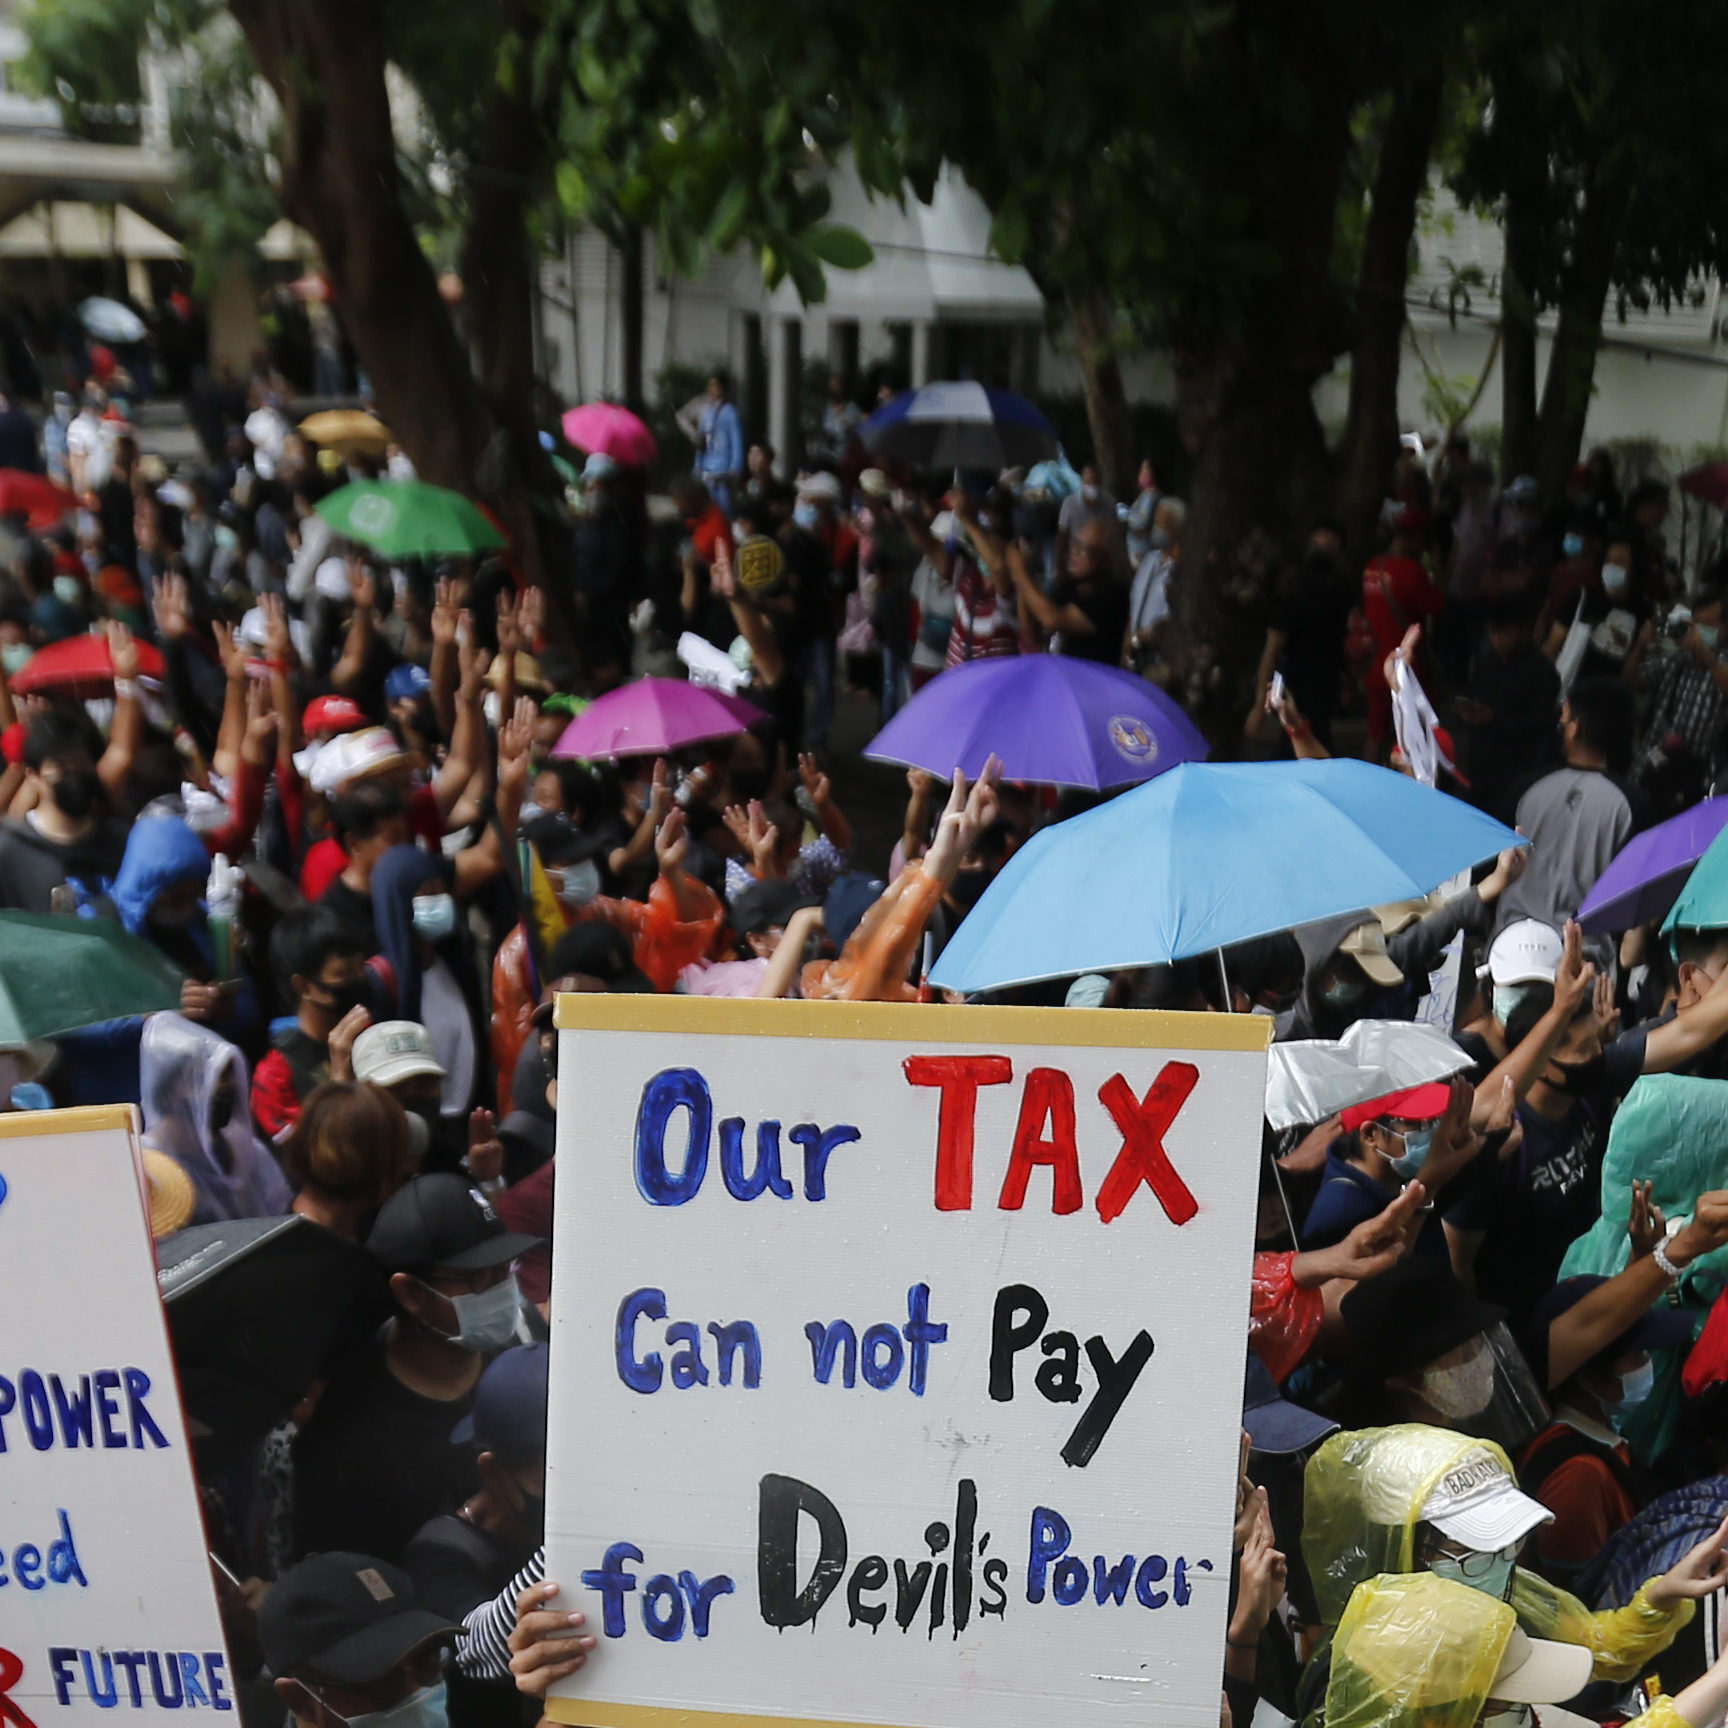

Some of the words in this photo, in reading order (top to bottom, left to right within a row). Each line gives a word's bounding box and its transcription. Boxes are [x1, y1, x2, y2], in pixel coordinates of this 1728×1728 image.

[634, 1067, 860, 1206] Our
[903, 1055, 1200, 1225] TAX
[616, 1286, 762, 1395] Can
[806, 1282, 948, 1397] not
[989, 1283, 1154, 1468] Pay
[582, 1541, 736, 1642] for
[757, 1471, 1009, 1642] Devil's
[1027, 1505, 1214, 1611] Power
[50, 1646, 234, 1712] FUTURE
